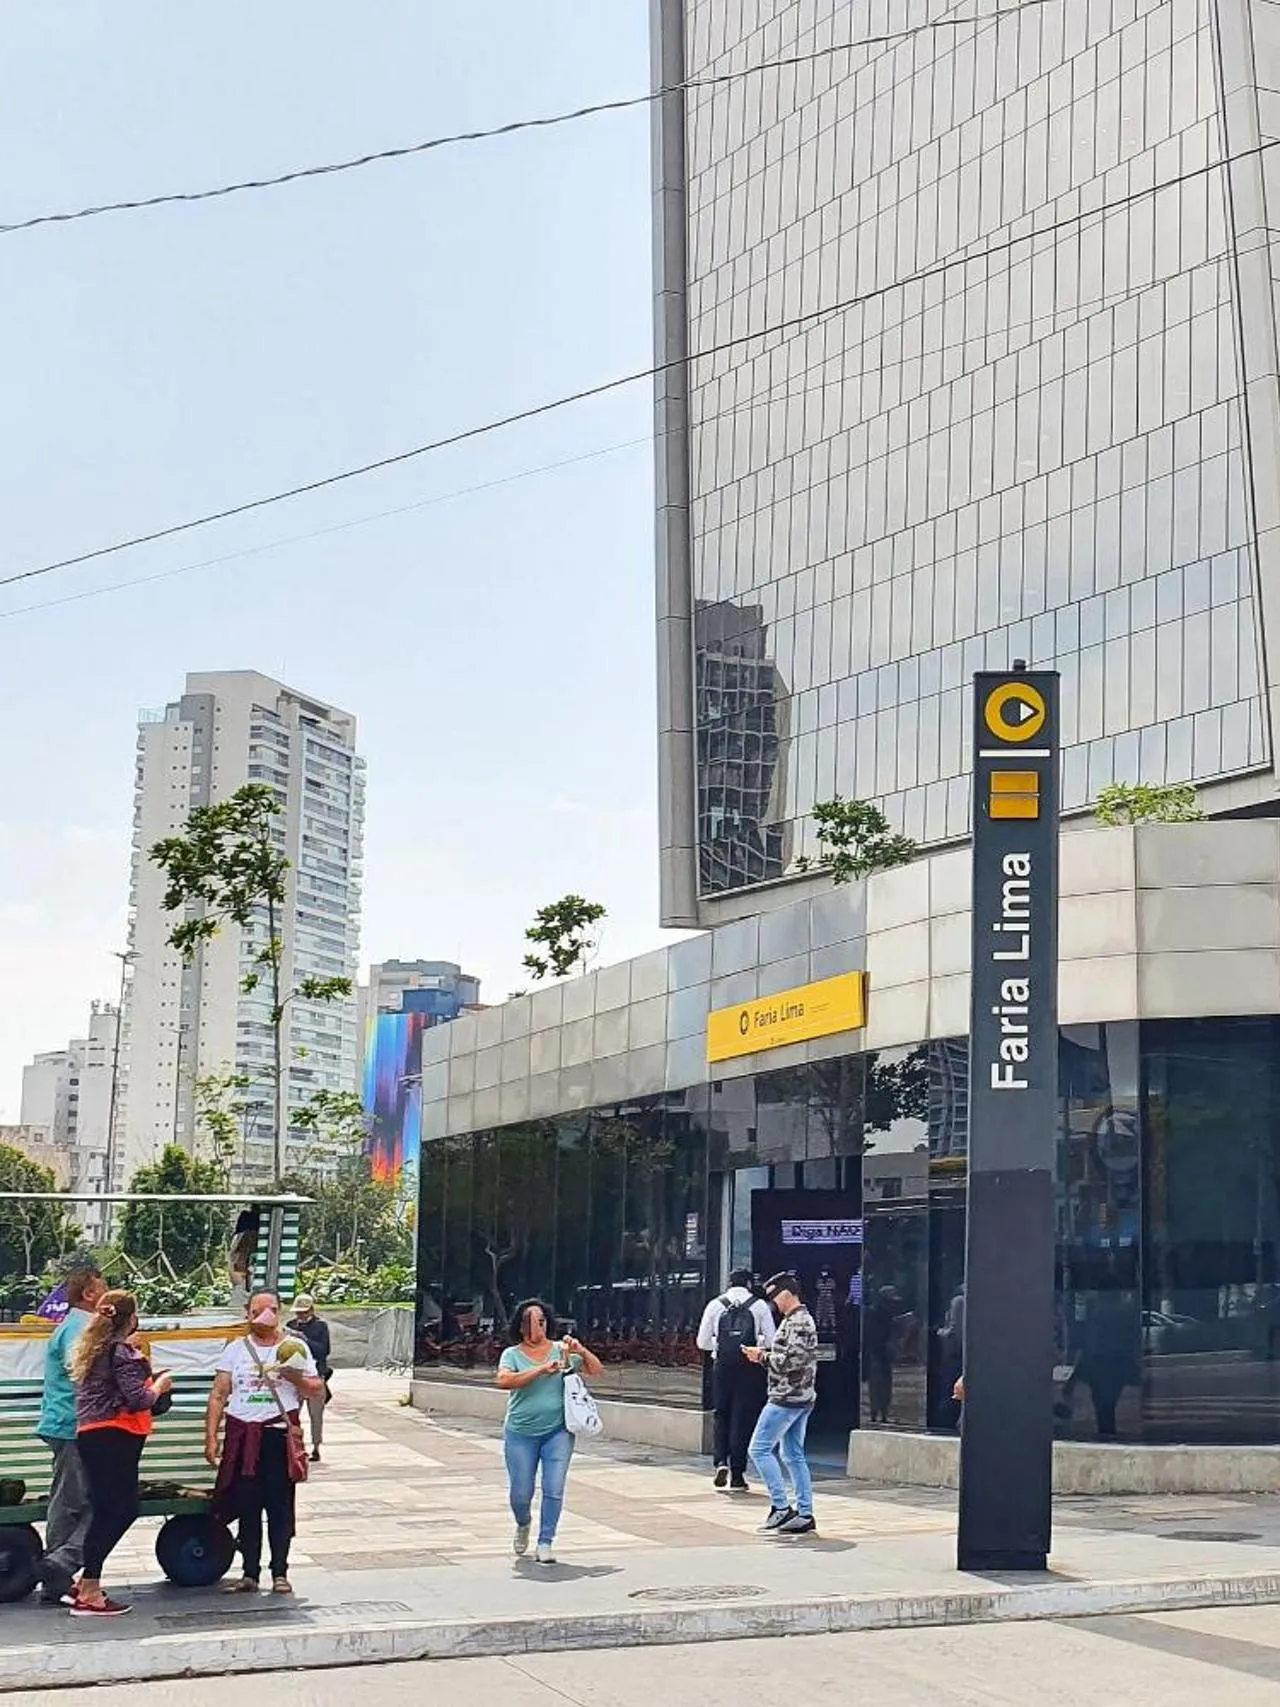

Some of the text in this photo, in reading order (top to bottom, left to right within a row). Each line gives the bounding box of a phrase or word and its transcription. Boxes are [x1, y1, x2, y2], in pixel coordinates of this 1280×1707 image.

[754, 1007, 777, 1029] Faria
[780, 1001, 805, 1022] Lima
[991, 851, 1032, 1090] Faria Lima
